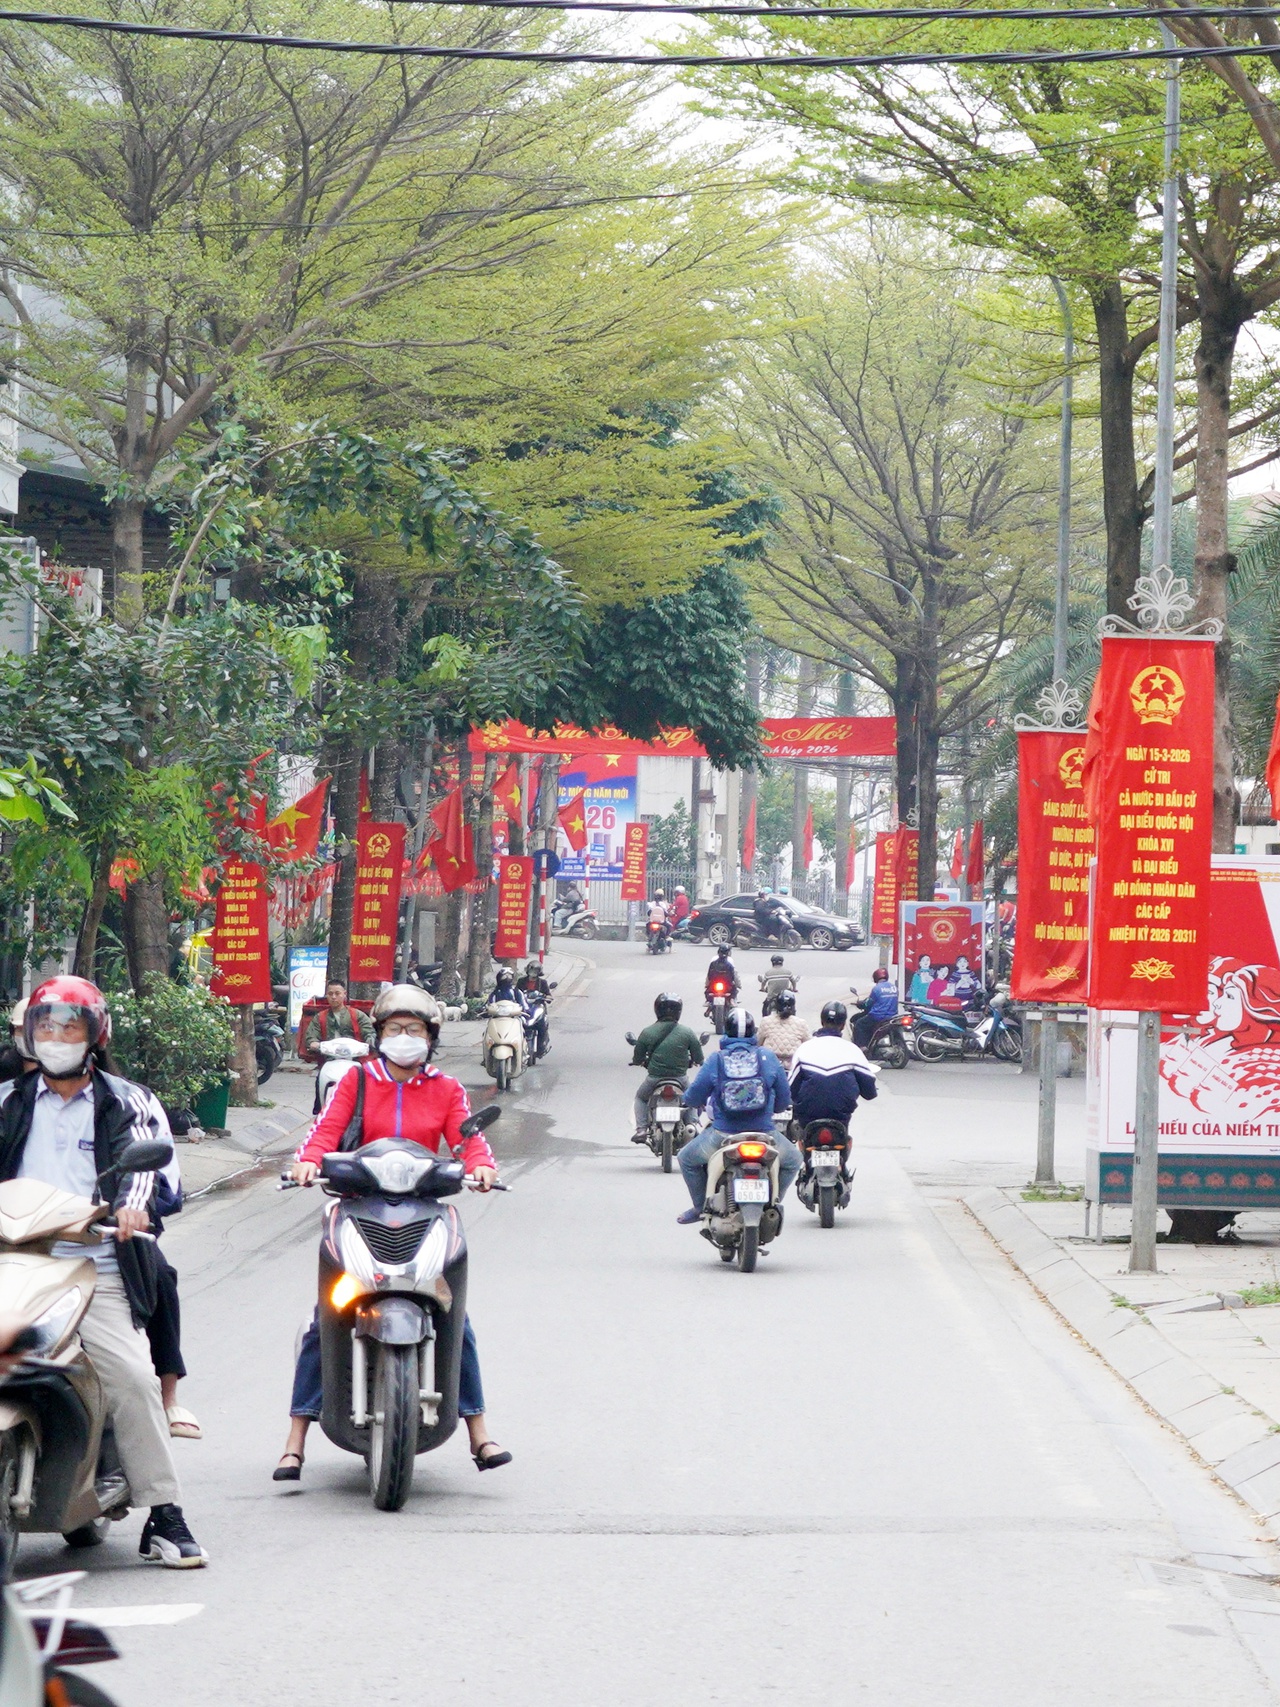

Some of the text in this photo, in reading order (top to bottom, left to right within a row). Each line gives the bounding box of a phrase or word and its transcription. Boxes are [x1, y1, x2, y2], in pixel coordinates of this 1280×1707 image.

[782, 722, 853, 741] Mới
[806, 745, 838, 754] 2026
[1126, 745, 1190, 762] NGÀY 15-3-2026
[1144, 766, 1170, 784] CỬ TRI
[593, 786, 612, 798] NĂM
[1119, 788, 1197, 808] CẢ NƯỚC ĐI BẦU CỬ
[1120, 810, 1193, 833] ĐẠI BIỂU QUỐC HỘI
[1137, 835, 1174, 852] KHÓA XVI
[1133, 856, 1178, 876] VÀ ĐẠI BIỂU
[1113, 879, 1195, 898] HỘI ĐỒNG NHÂN DÂN
[1136, 902, 1171, 919] CÁC CẤP
[1109, 925, 1136, 943] NHIỆM
[1138, 925, 1149, 941] KỲ
[1150, 928, 1170, 942] 2026
[1158, 1119, 1187, 1136] HIẾU
[1192, 1119, 1218, 1136] CỦA
[1226, 1120, 1262, 1137] NIỀM
